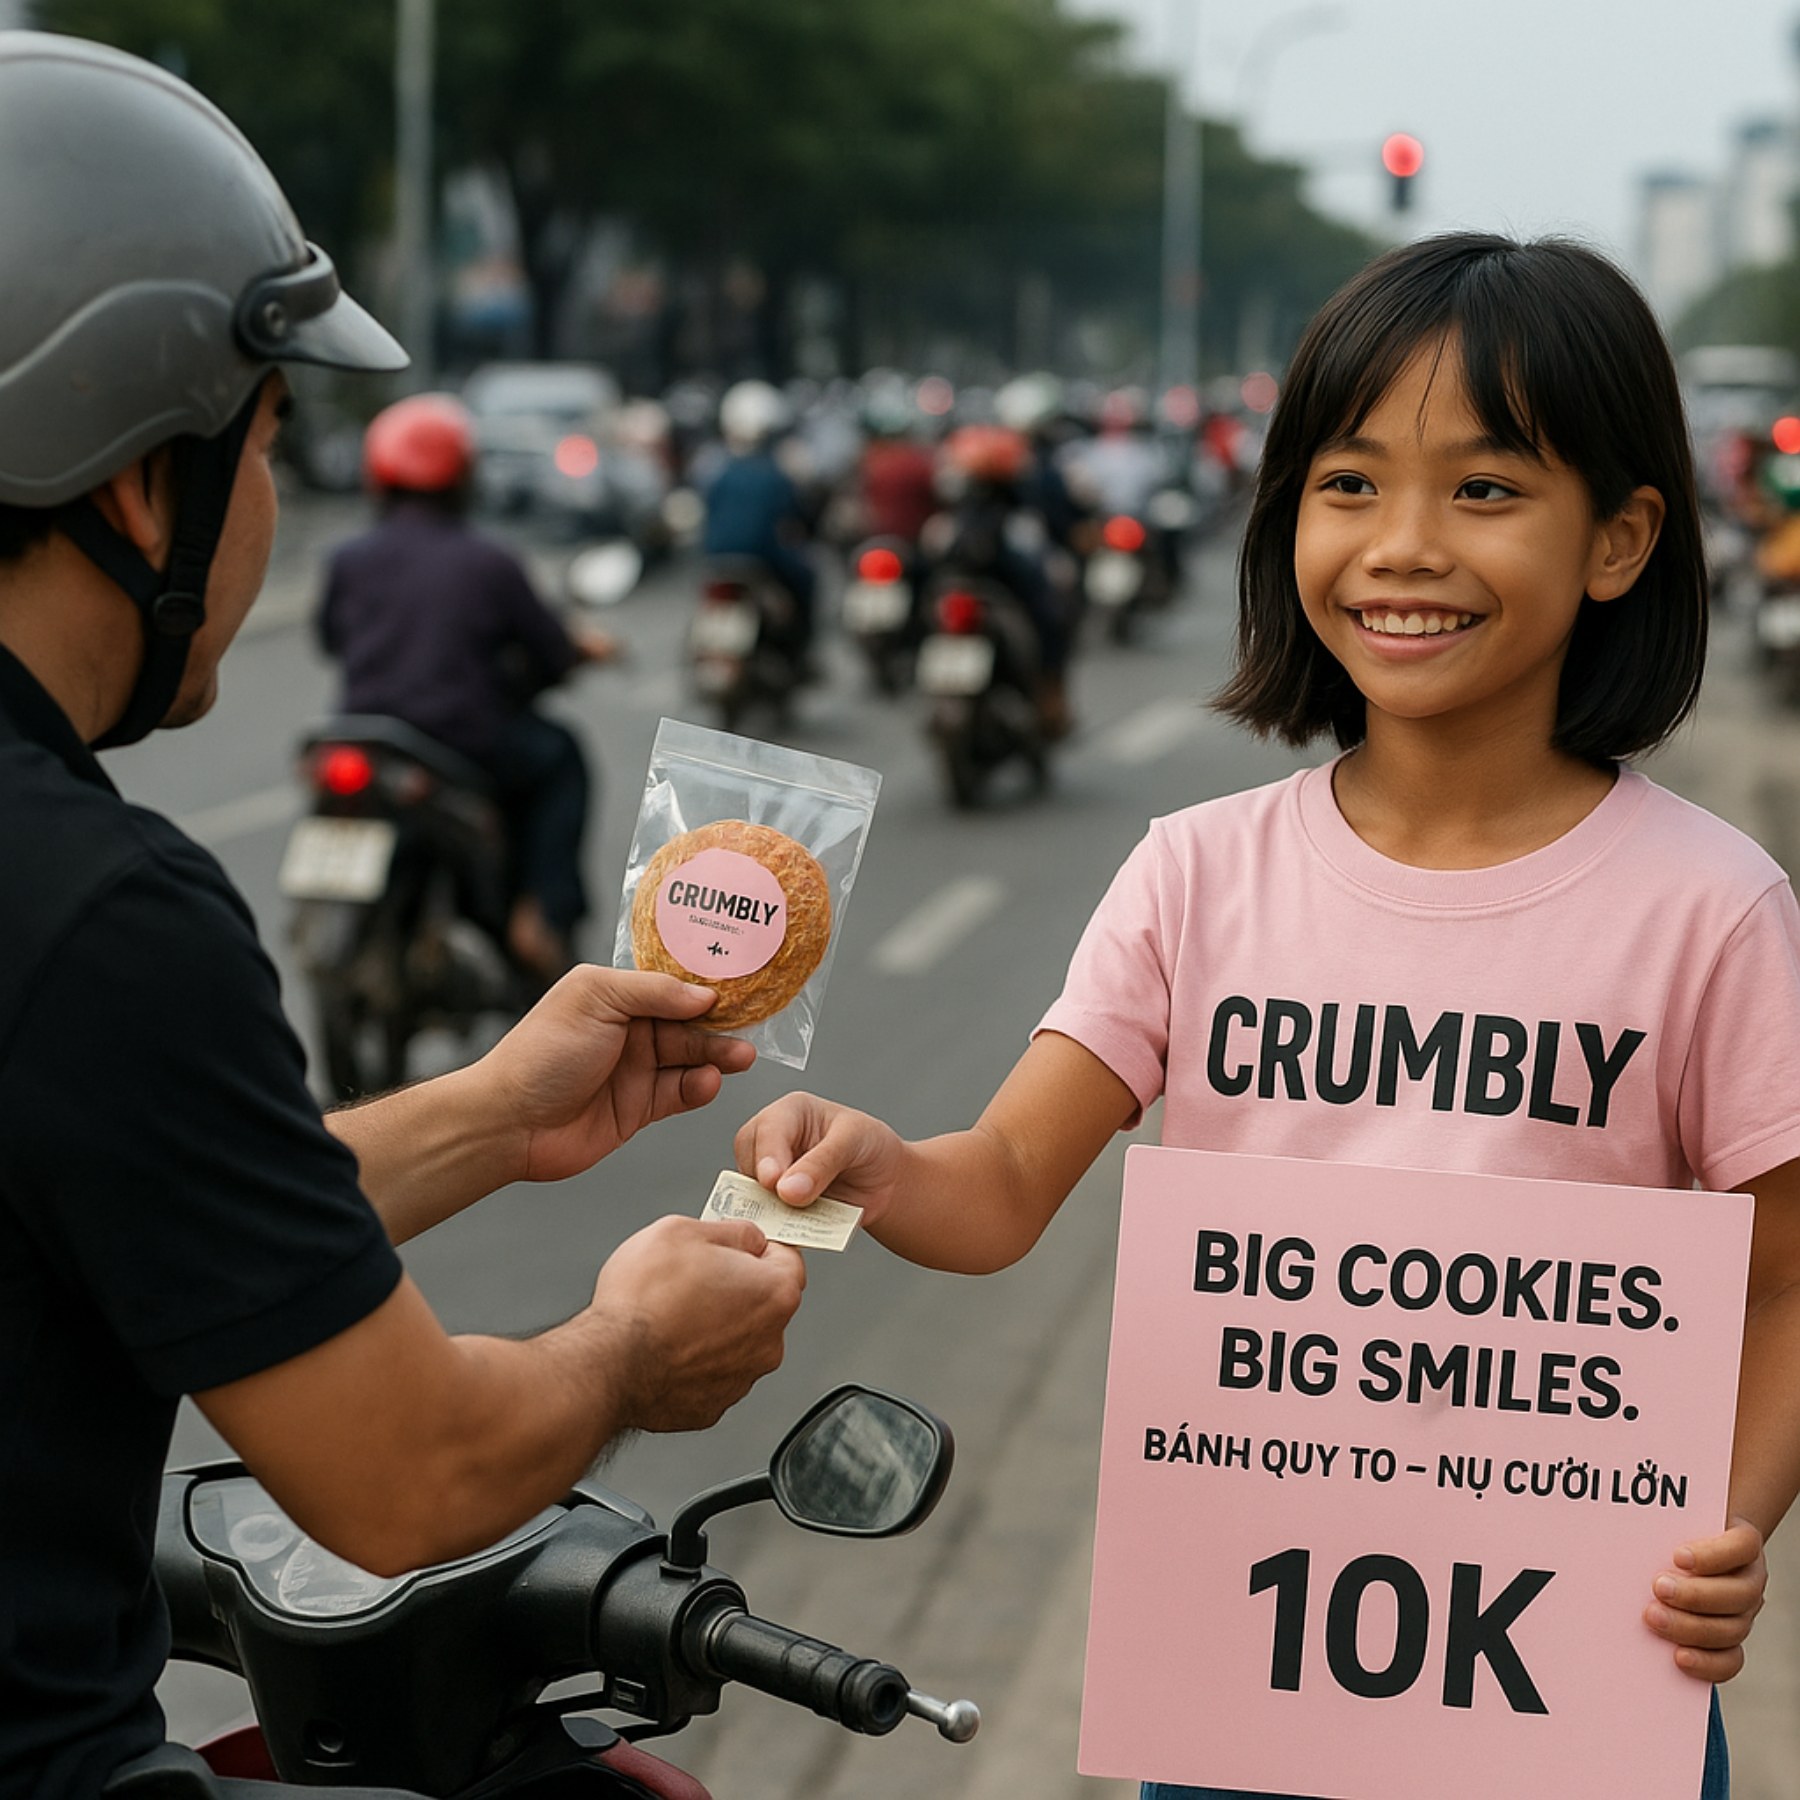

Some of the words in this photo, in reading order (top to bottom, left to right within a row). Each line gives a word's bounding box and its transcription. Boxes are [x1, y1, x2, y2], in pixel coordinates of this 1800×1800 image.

[668, 880, 780, 927] CRUMBLY
[1207, 995, 1648, 1129] CRUMBLY
[1193, 1229, 1316, 1302] BIG
[1338, 1244, 1679, 1332] COOKIES.
[1218, 1326, 1339, 1397] BIG
[1358, 1339, 1639, 1421] SMILES.
[1143, 1422, 1251, 1471] BÁNH
[1261, 1439, 1340, 1479] QUY
[1349, 1446, 1397, 1483] TO
[1437, 1454, 1492, 1500] NỤ
[1249, 1548, 1557, 1715] 10K
